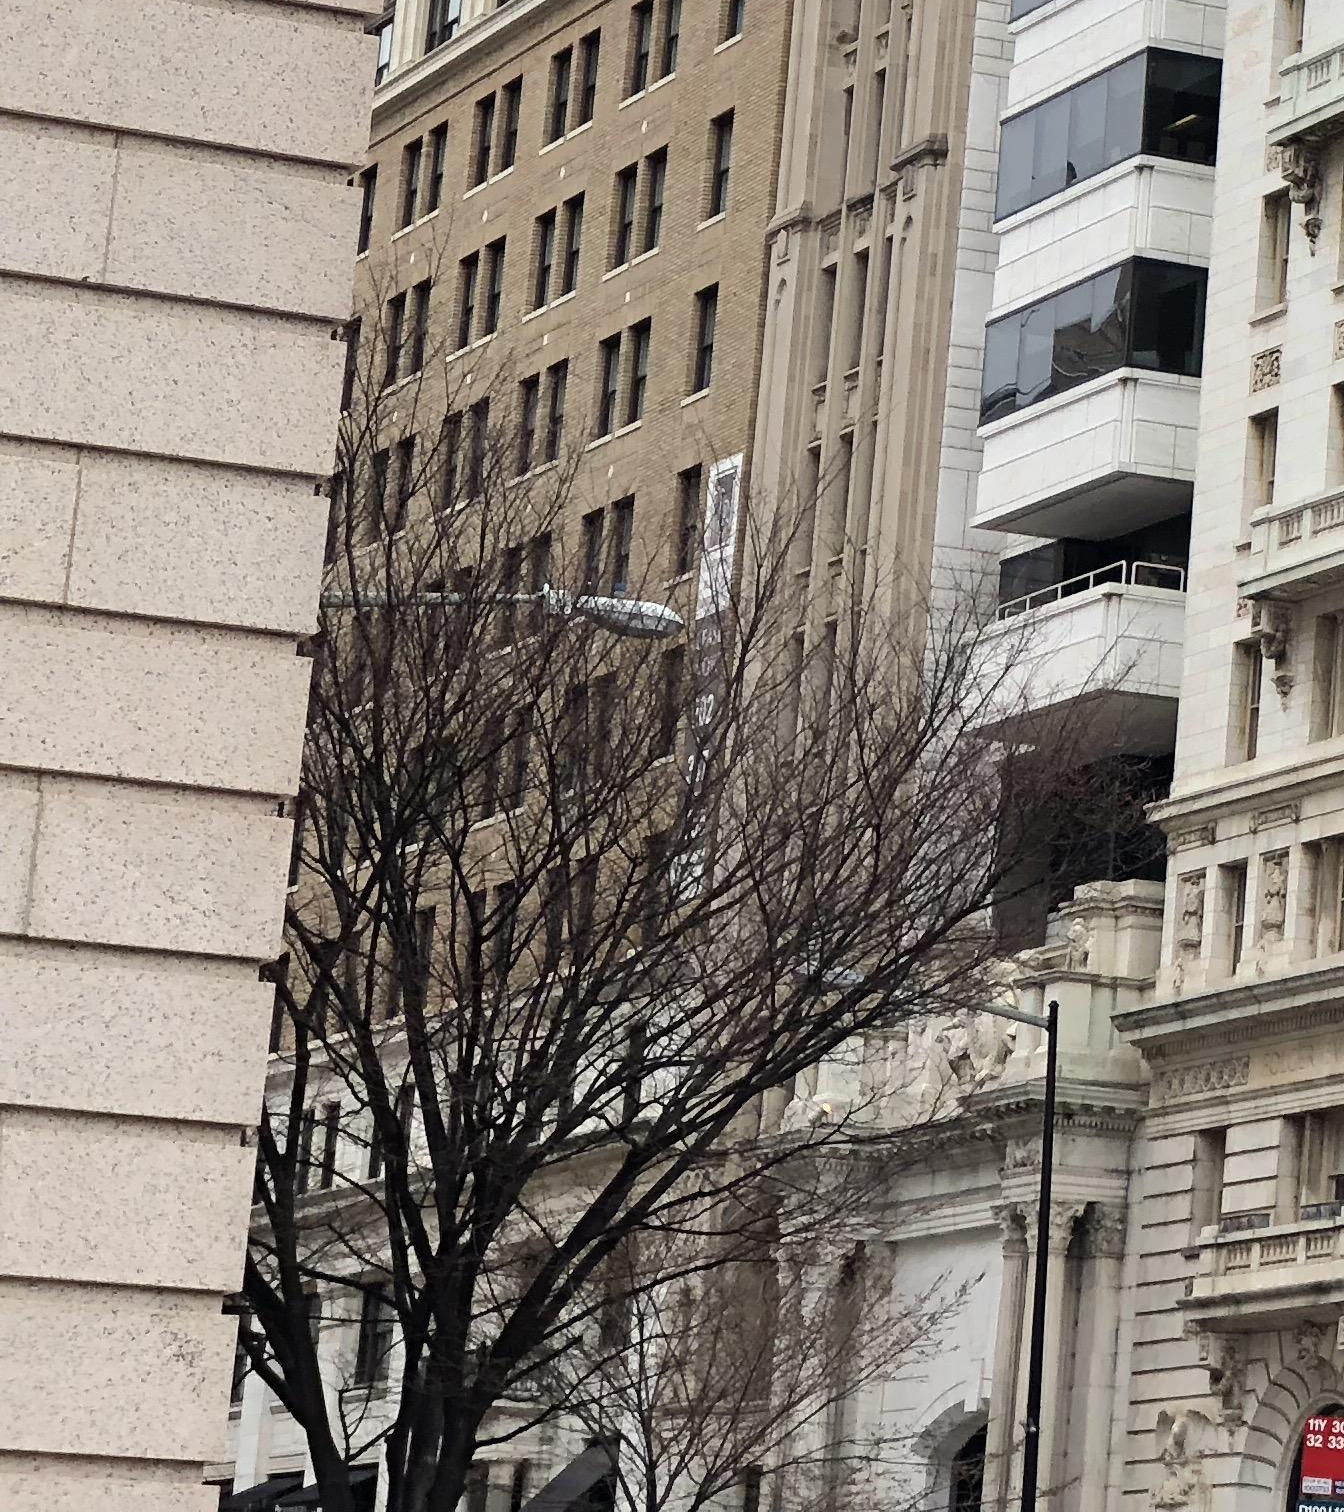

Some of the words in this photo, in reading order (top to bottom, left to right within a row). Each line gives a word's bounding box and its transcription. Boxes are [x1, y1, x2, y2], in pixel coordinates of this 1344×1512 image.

[1308, 1418, 1327, 1431] 11Y
[1306, 1434, 1323, 1447] 32
[1327, 1436, 1344, 1450] 33
